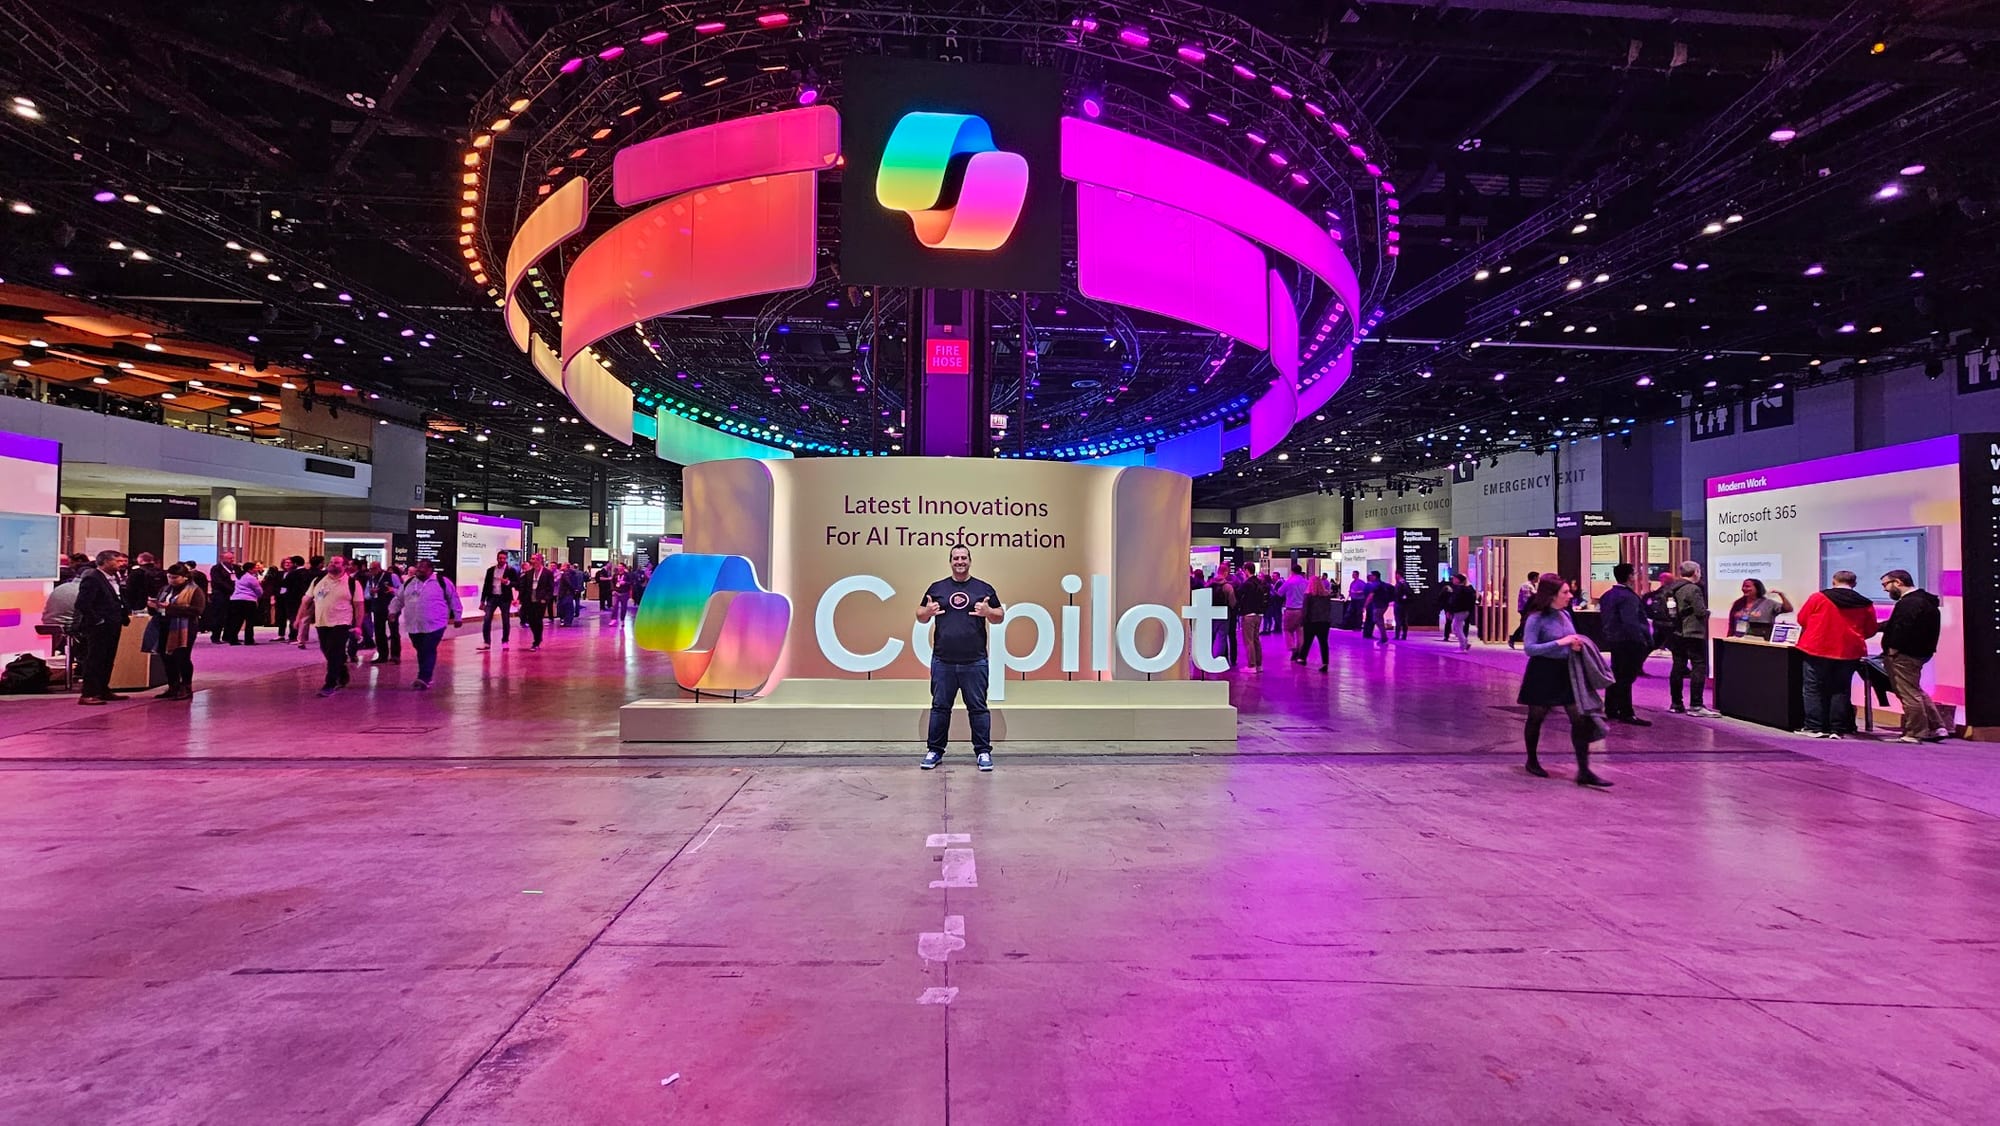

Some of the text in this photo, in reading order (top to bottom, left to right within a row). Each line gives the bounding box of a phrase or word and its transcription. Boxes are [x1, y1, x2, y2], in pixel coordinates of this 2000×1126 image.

[935, 345, 960, 356] FIRE
[932, 357, 963, 367] HOSE
[1483, 468, 1586, 496] EMERGENCY EXIT
[1717, 476, 1767, 493] Modern Work
[844, 495, 1049, 517] Latest Innovations
[1365, 509, 1379, 519] EXIT
[1381, 507, 1389, 517] TO
[1390, 503, 1421, 515] CENTRAL
[1718, 505, 1797, 524] Microsoft 365
[826, 526, 1065, 548] For AI Transformation
[1223, 527, 1250, 535] Zone 2
[1718, 529, 1759, 547] Copilot
